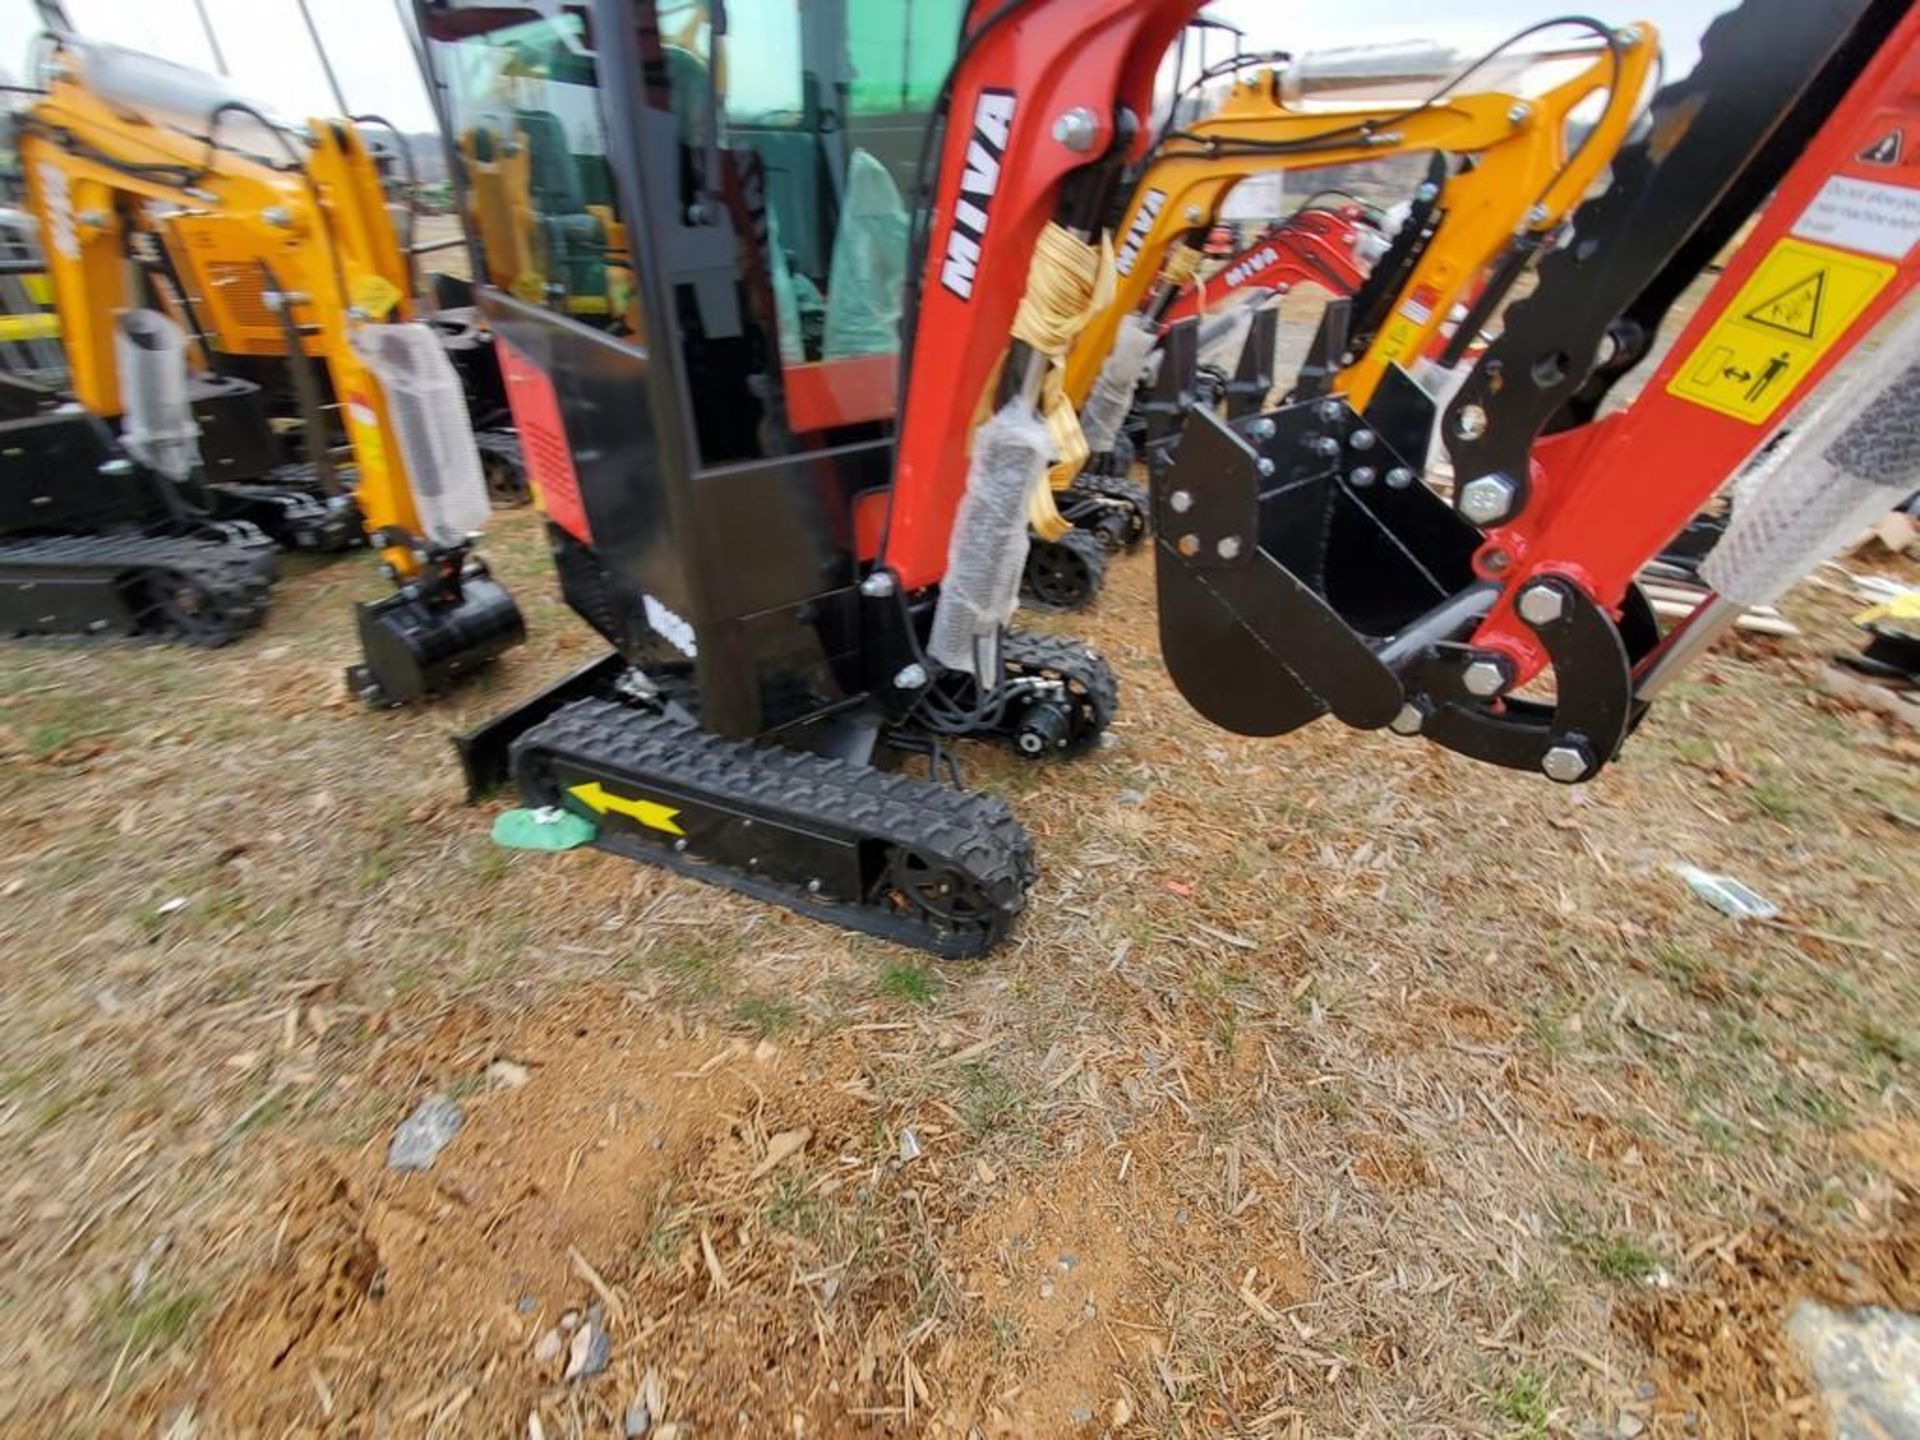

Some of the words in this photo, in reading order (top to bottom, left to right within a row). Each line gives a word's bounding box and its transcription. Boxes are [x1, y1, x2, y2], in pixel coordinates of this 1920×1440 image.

[941, 91, 1018, 300] MIVA
[1115, 189, 1168, 275] MIVA
[1225, 246, 1279, 287] MIVA
